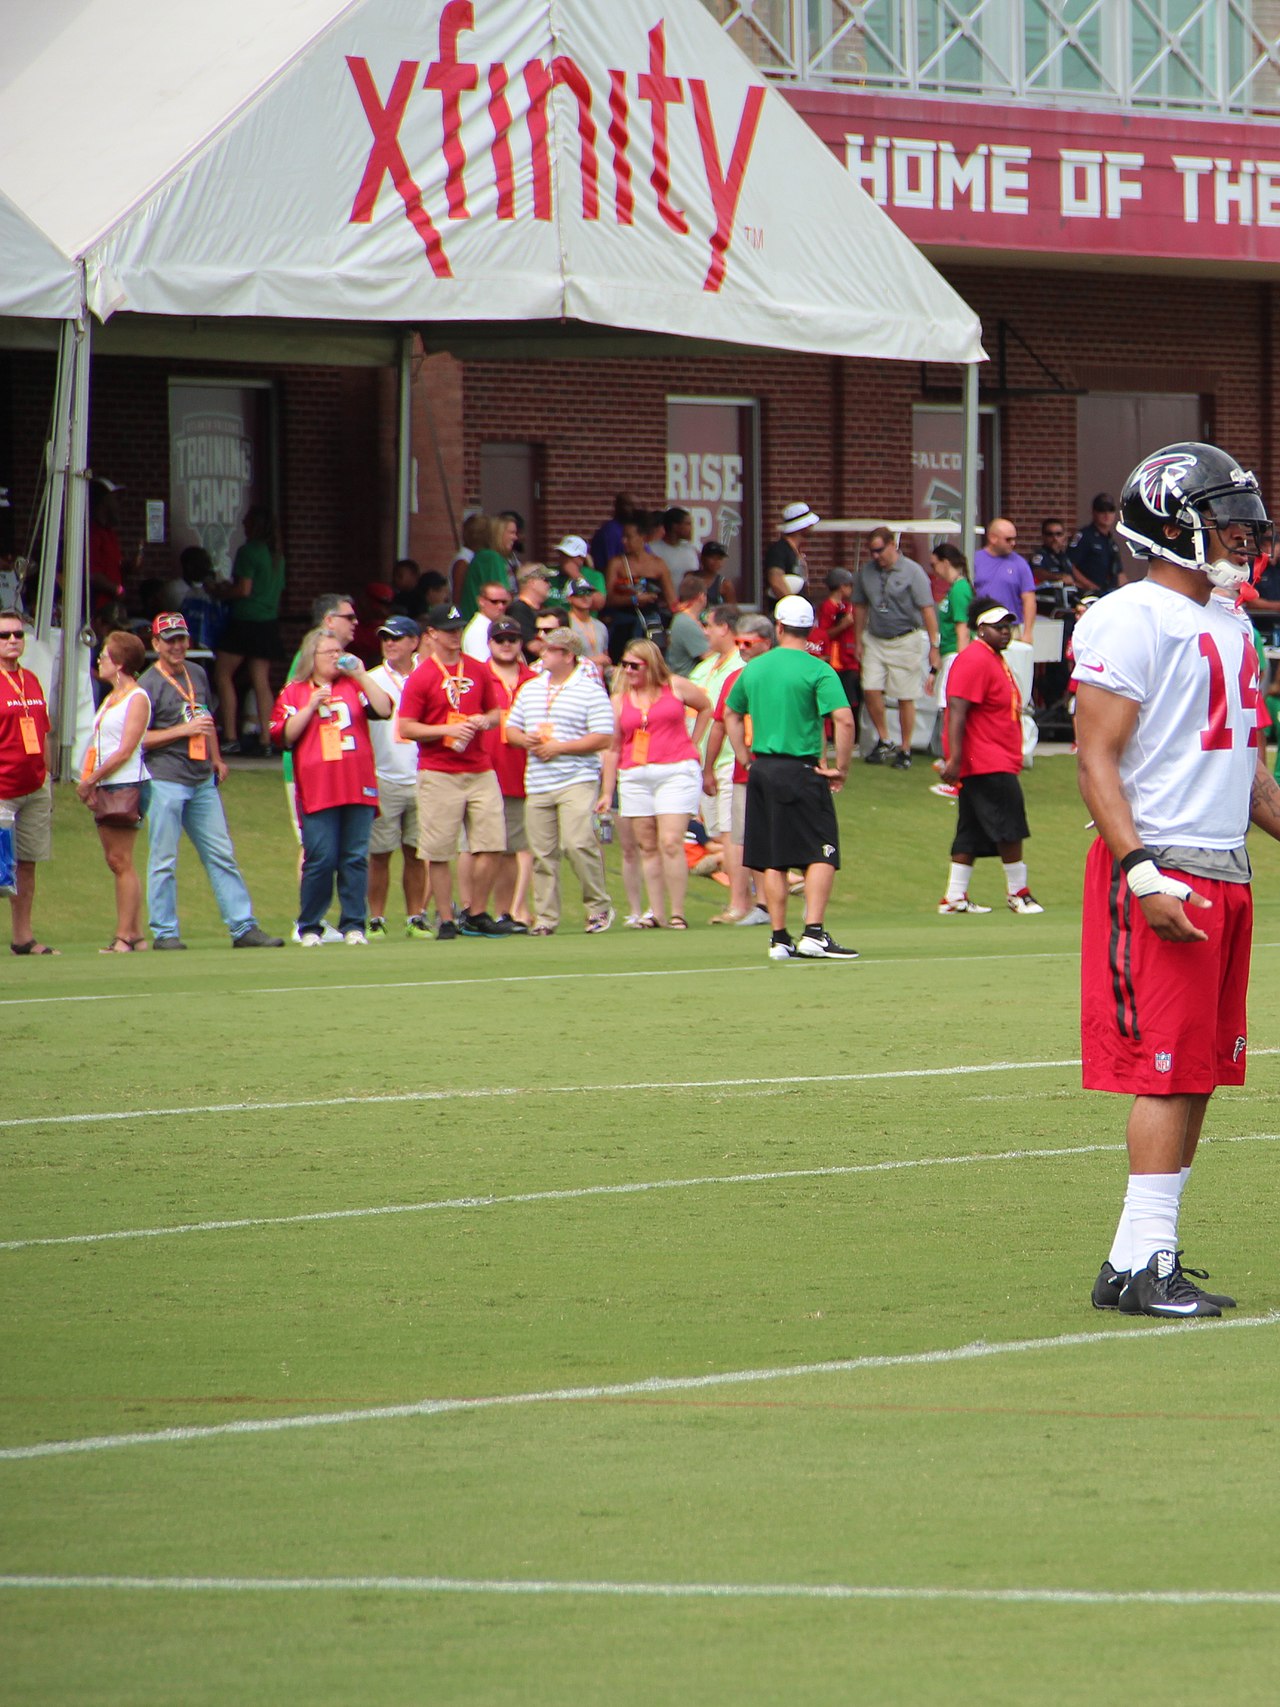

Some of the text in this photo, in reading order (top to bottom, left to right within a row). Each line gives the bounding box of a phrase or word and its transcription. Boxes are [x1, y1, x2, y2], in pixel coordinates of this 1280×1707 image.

[345, 0, 766, 292] xfinity
[844, 133, 1031, 215] HOME
[1059, 149, 1144, 219] OF
[176, 435, 252, 481] TRAINING
[665, 453, 743, 502] RISE
[912, 451, 984, 470] FALCOS
[188, 478, 240, 524] CAMP
